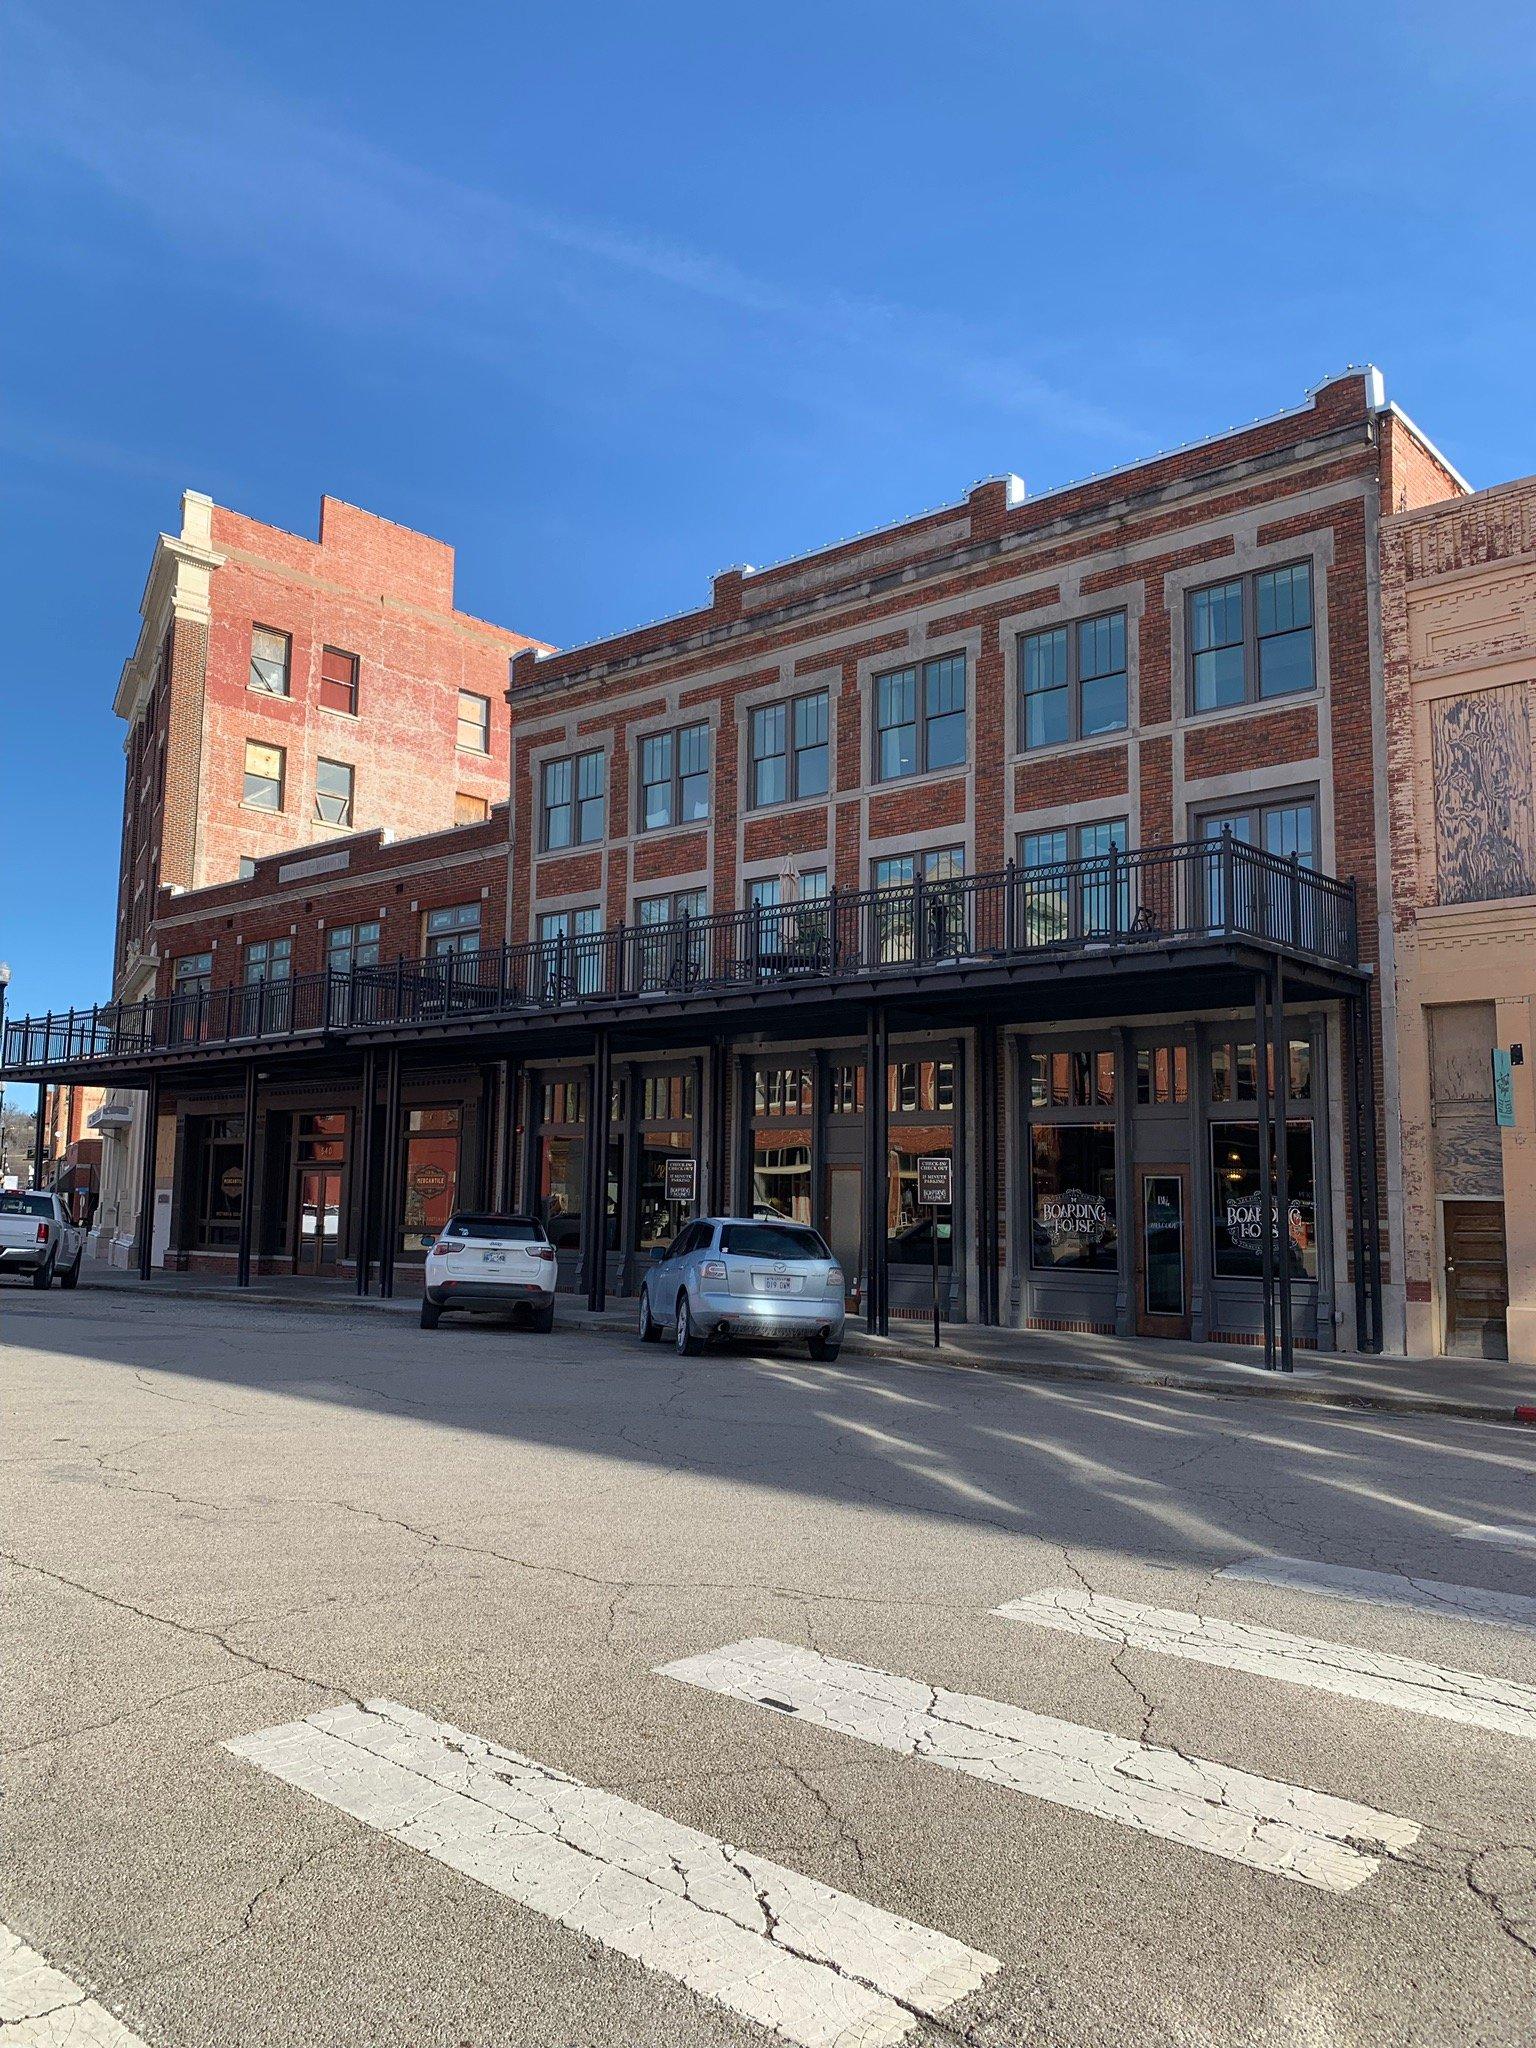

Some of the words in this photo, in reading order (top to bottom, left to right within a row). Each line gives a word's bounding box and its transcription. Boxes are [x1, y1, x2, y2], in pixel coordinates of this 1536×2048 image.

[416, 1176, 445, 1184] MERCANTILE
[1043, 1203, 1107, 1223] BOARDING
[1055, 1219, 1095, 1233] HOUSE
